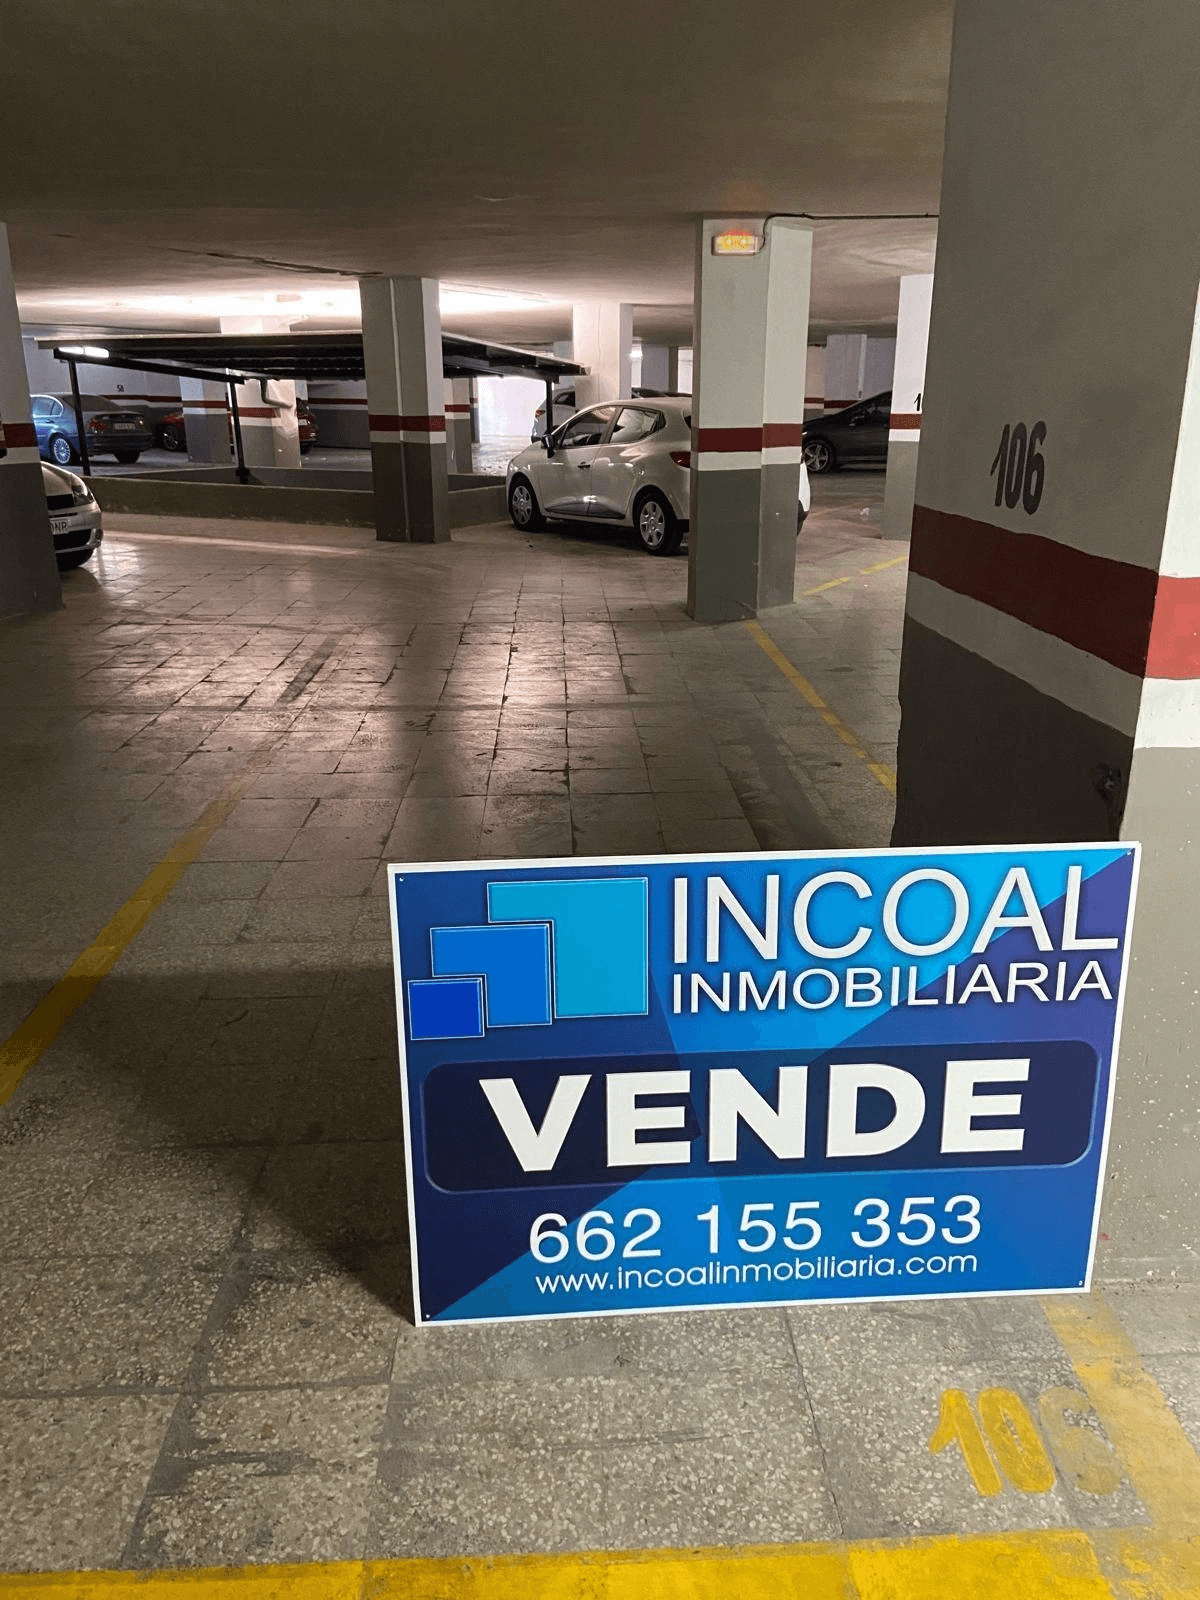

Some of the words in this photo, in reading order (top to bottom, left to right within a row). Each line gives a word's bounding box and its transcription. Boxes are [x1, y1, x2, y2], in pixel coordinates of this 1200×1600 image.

[990, 420, 1047, 516] 106
[673, 864, 1120, 964] INCOAL
[672, 960, 1113, 1014] INMOBILIARIA
[478, 1057, 1032, 1172] VENDE
[528, 1207, 662, 1264] 662
[696, 1201, 822, 1253] 155
[850, 1194, 981, 1248] 353
[534, 1253, 978, 1294] www.incoalinmobiliaria.com
